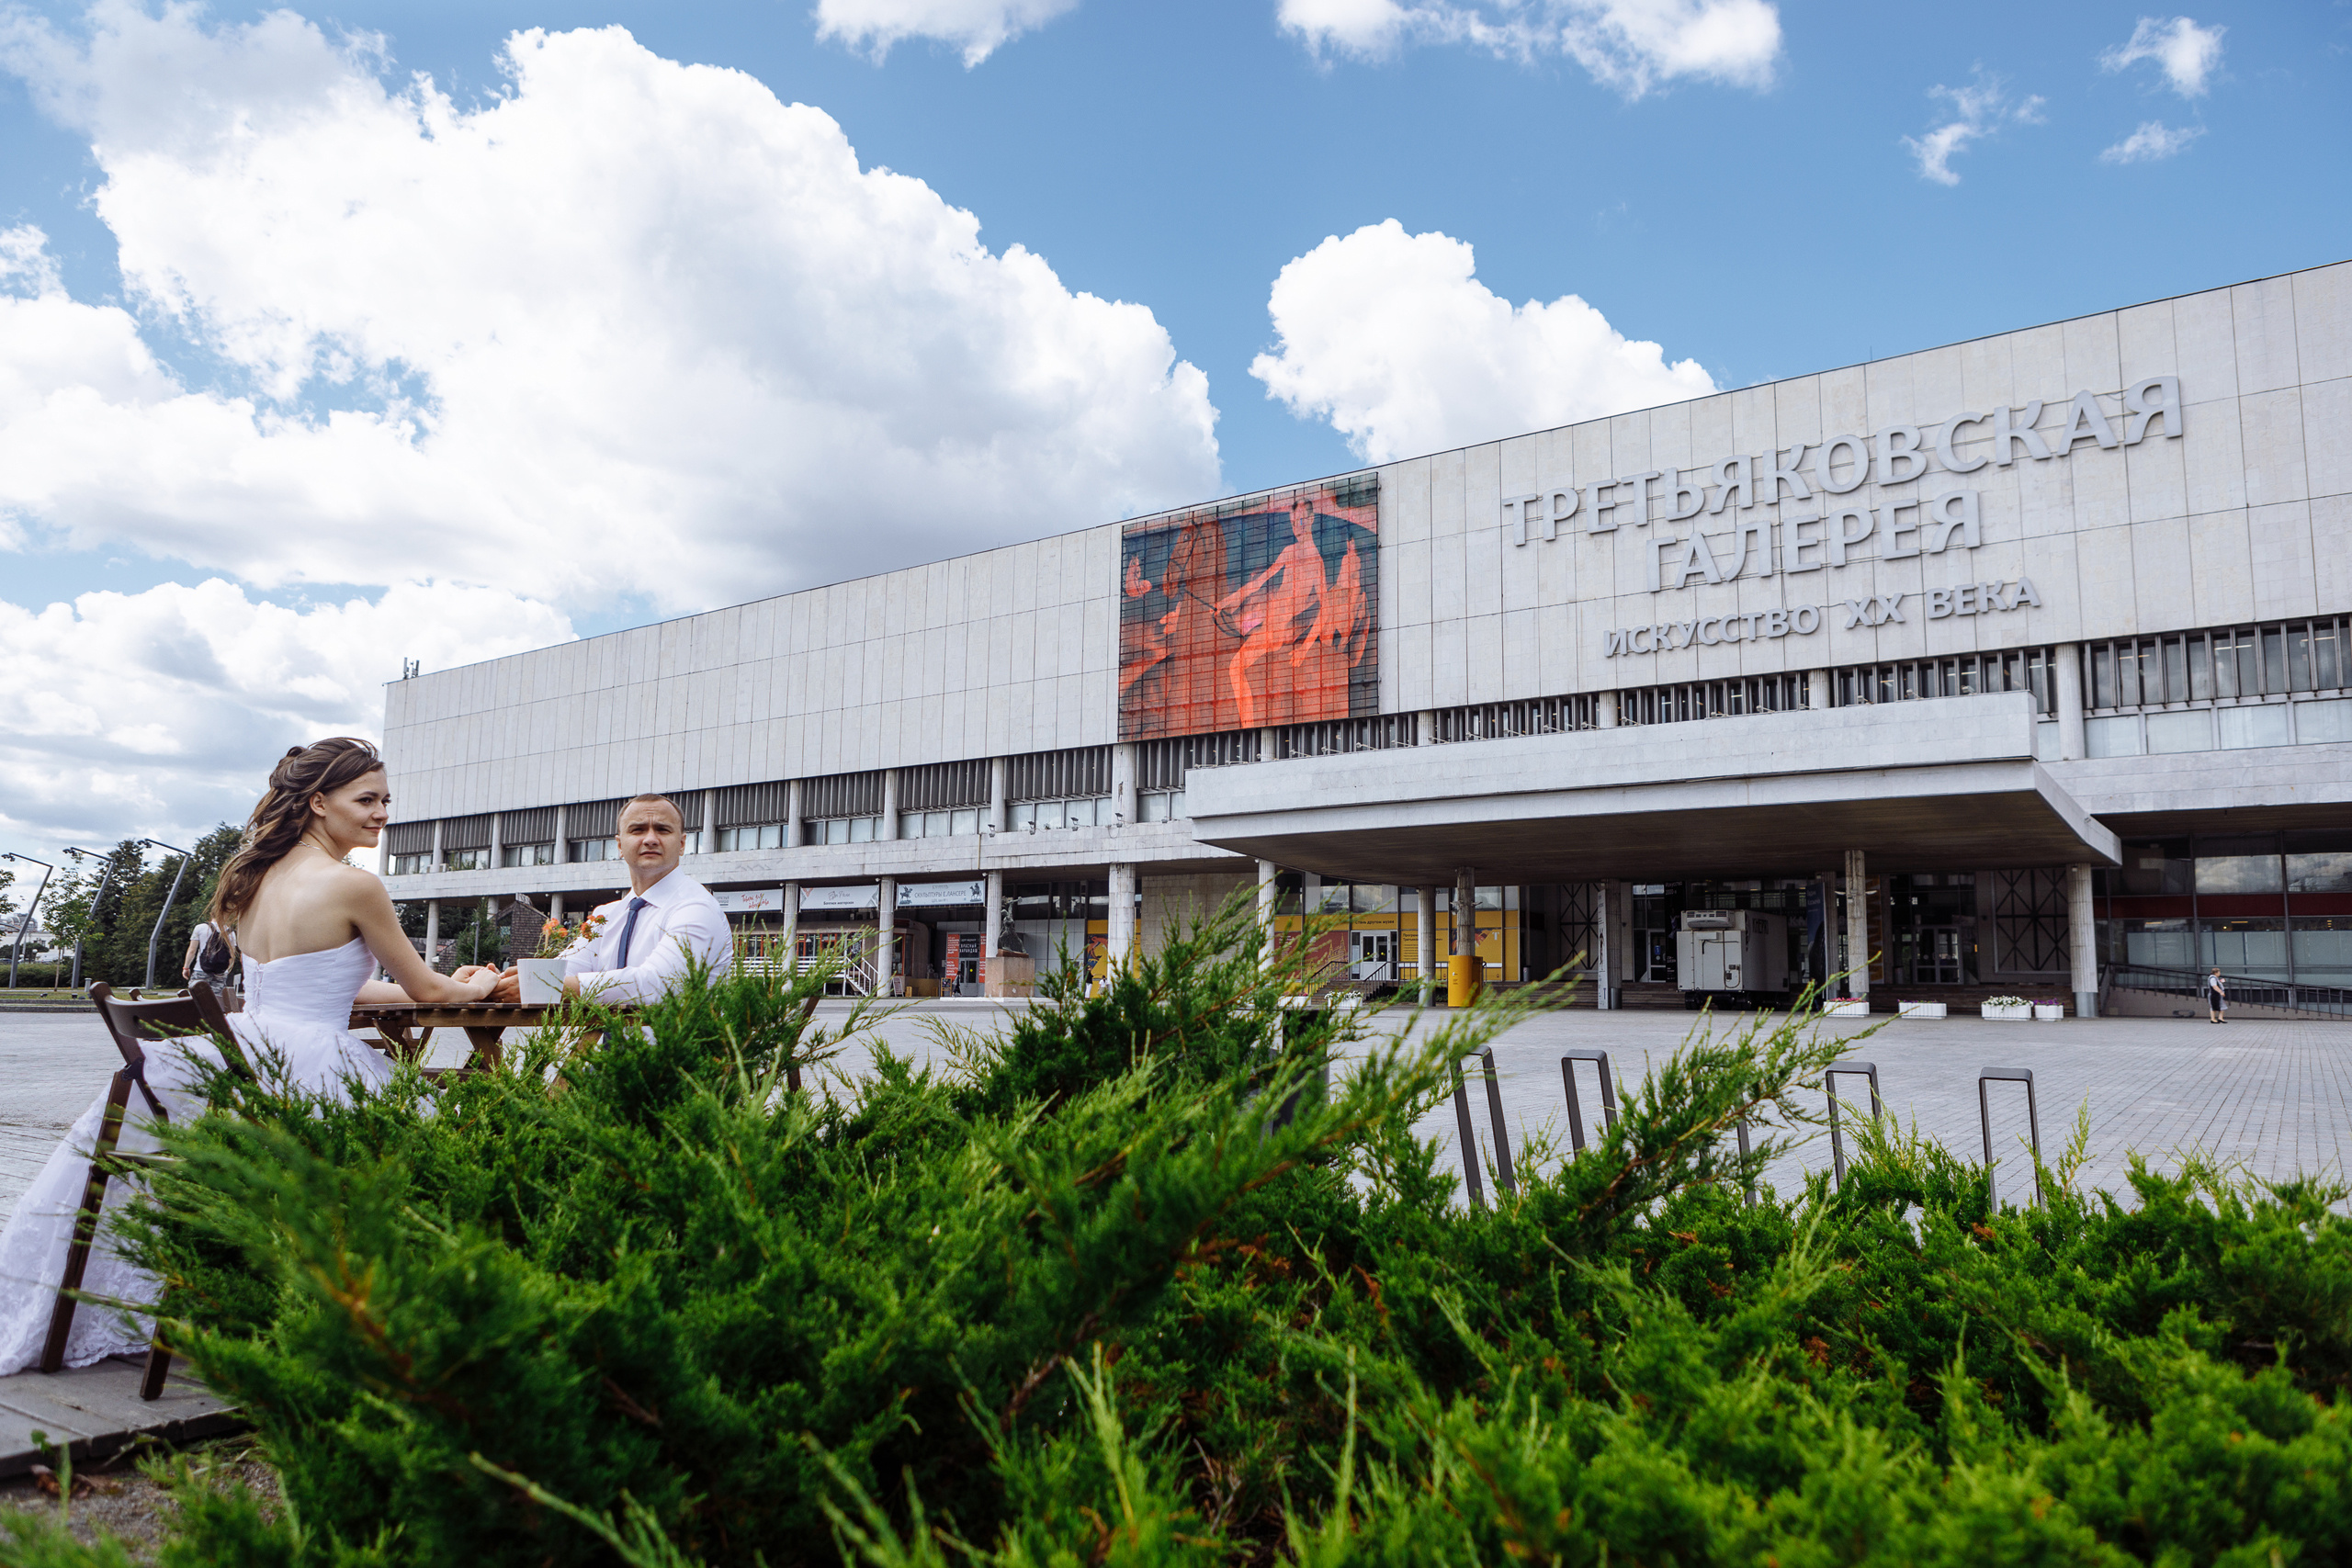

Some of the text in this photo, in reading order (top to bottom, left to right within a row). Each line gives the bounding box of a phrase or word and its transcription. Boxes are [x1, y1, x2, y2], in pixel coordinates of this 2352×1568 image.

[1502, 375, 2183, 547] ТРЕТЬЯКОВСКАЯ
[1646, 489, 1982, 592] ГАЛЕРЕЯ
[1603, 604, 1821, 658] ИСКУССТВО
[1928, 576, 2041, 619] ВЕКА
